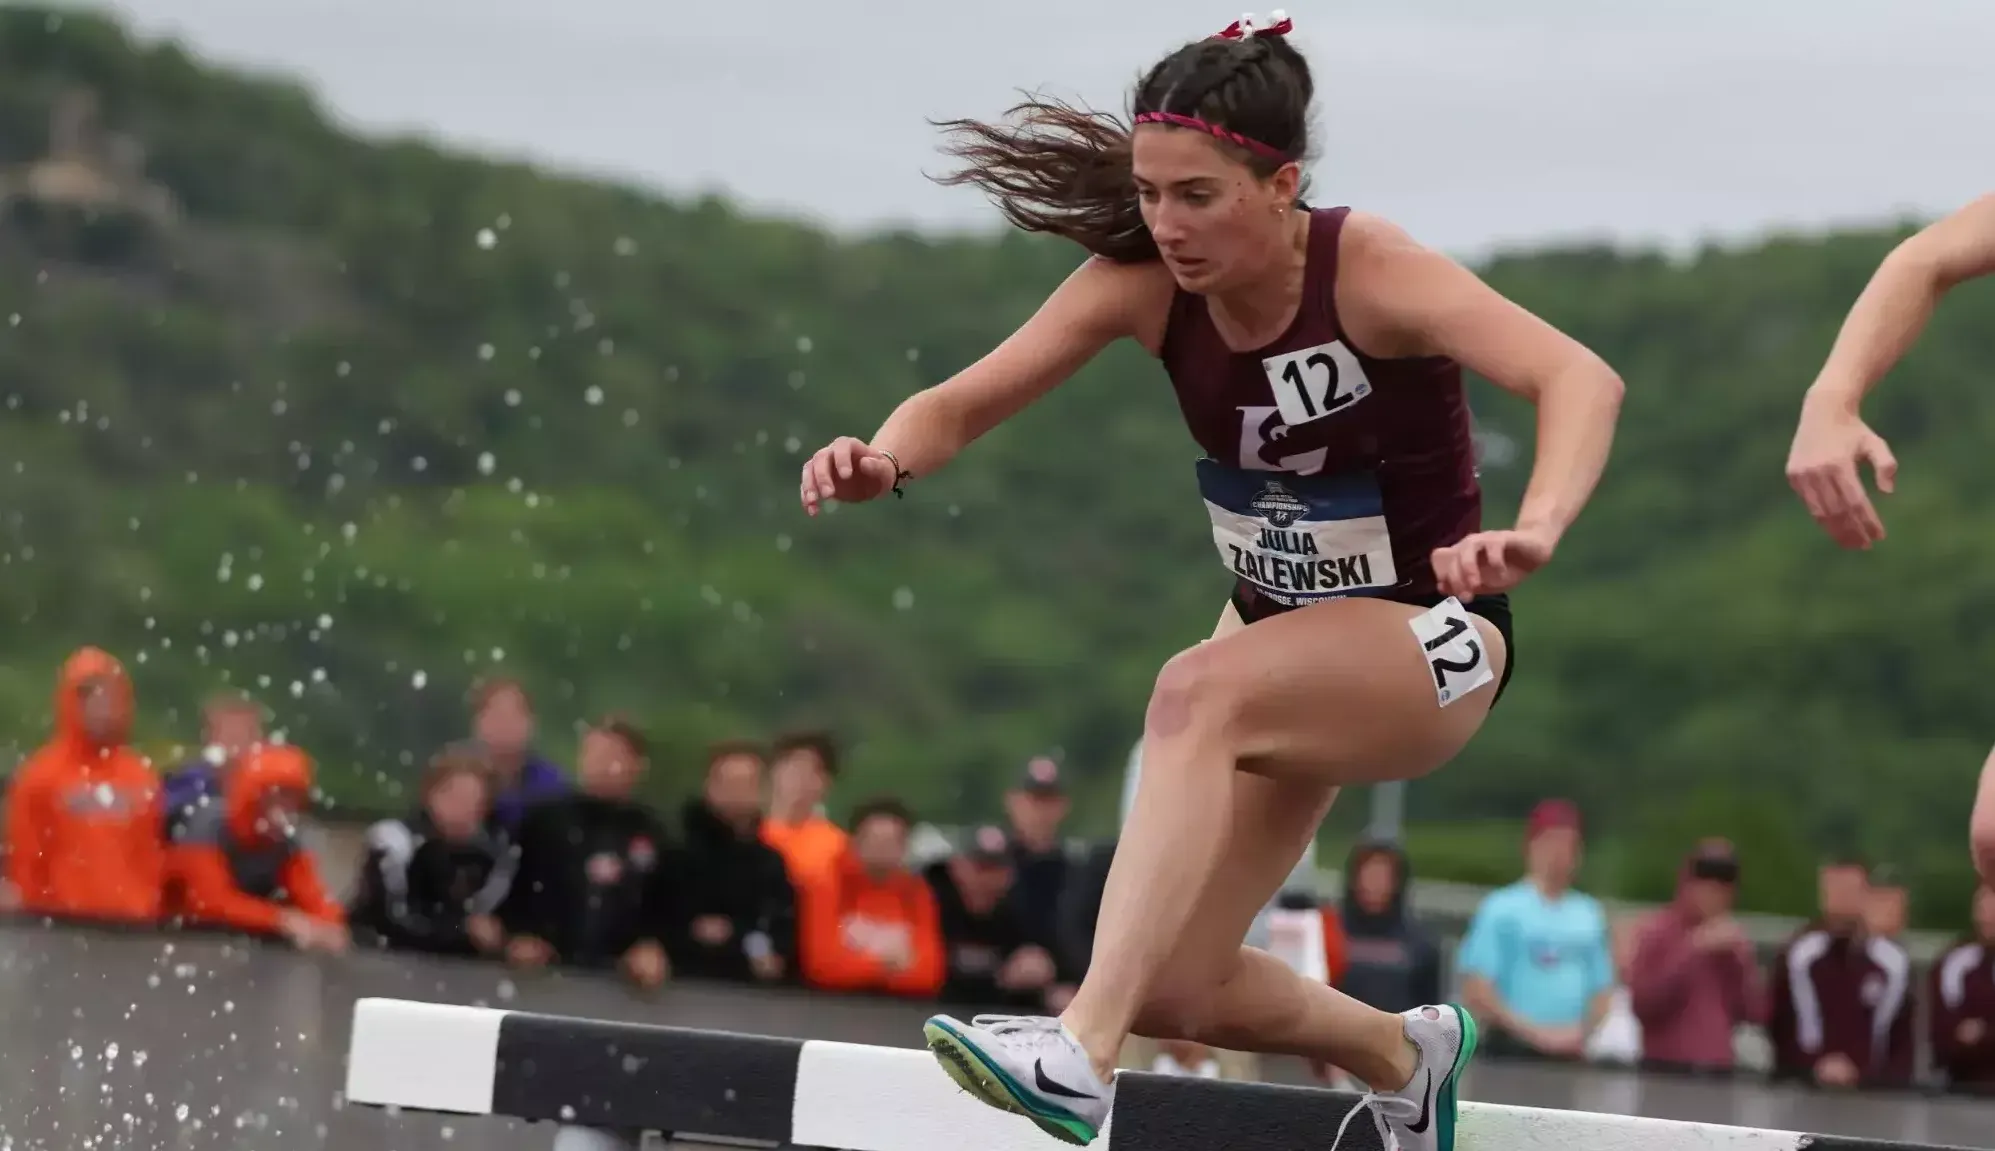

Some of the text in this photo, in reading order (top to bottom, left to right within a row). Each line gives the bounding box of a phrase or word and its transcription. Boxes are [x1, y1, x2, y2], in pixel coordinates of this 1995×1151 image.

[1282, 353, 1354, 417] 12
[1252, 501, 1309, 512] CHAMPIONSHIPS
[1256, 528, 1319, 555] JULIA
[1229, 543, 1373, 591] ZALEWSKI
[1424, 616, 1480, 690] 12
